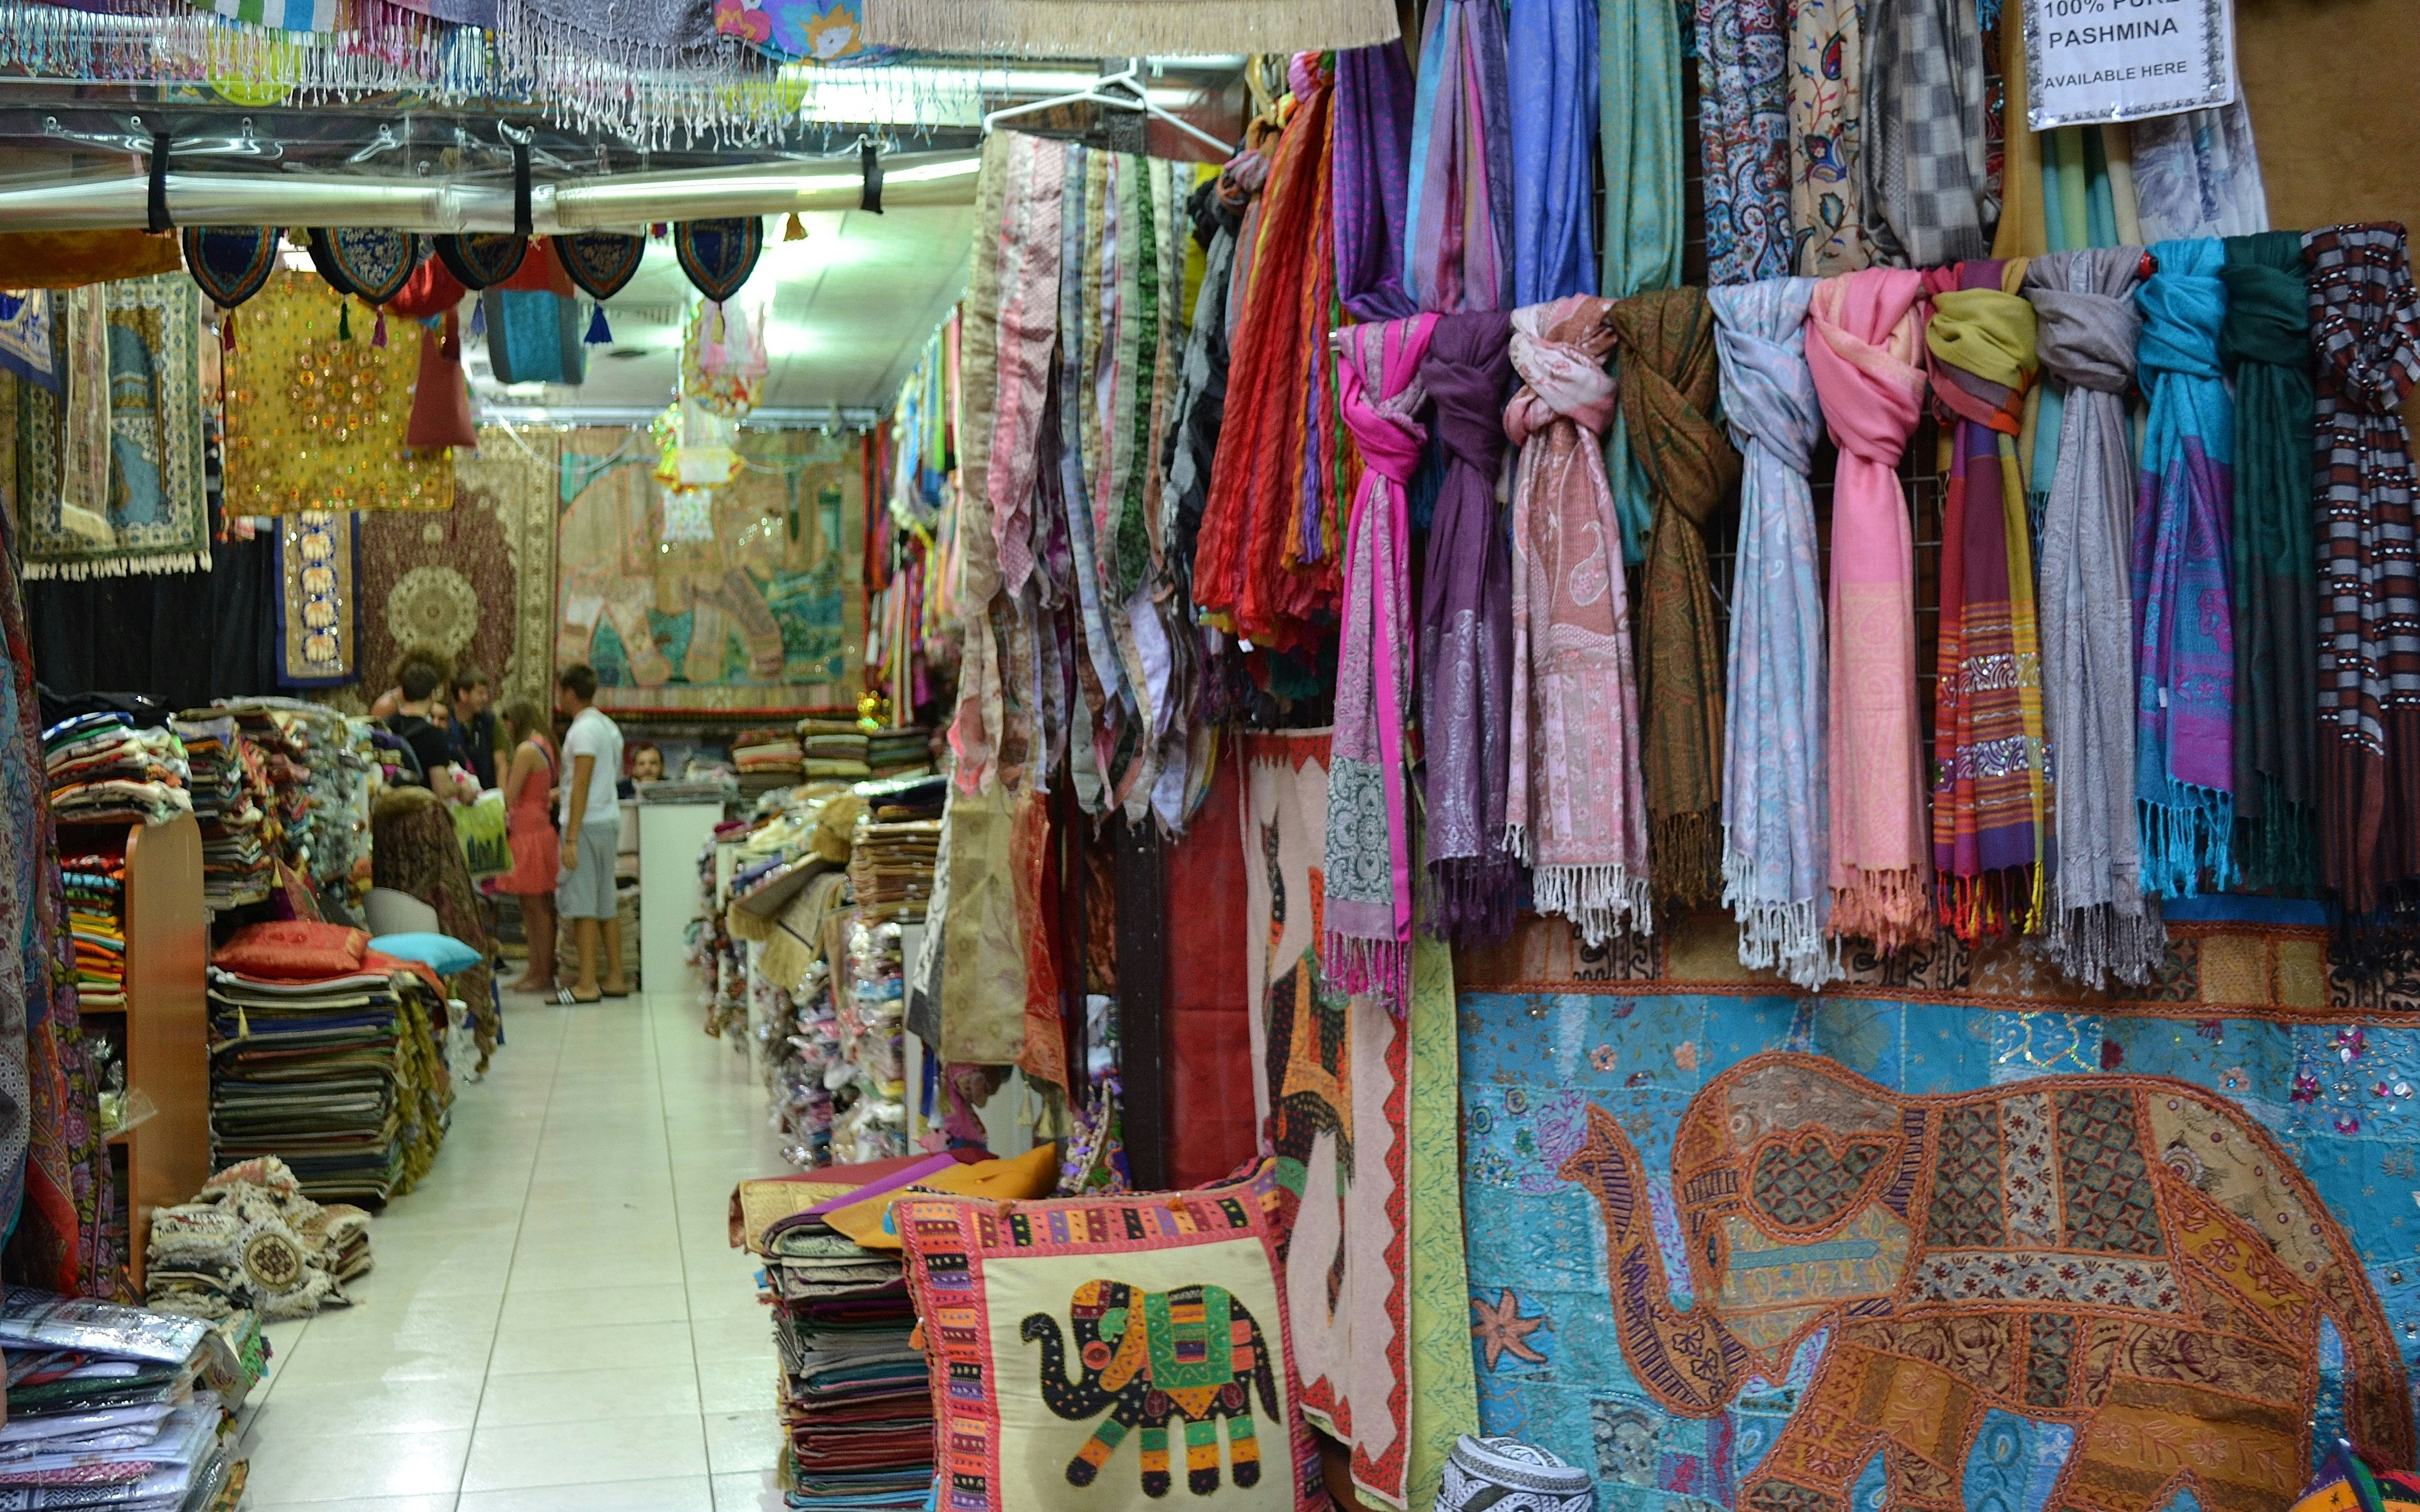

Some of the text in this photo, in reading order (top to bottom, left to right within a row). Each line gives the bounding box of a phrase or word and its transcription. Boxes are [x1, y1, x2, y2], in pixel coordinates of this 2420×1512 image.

[2045, 0, 2104, 18] 100%
[2049, 18, 2178, 48] PASHMINA
[2044, 61, 2187, 89] AVAILABLE HERE
